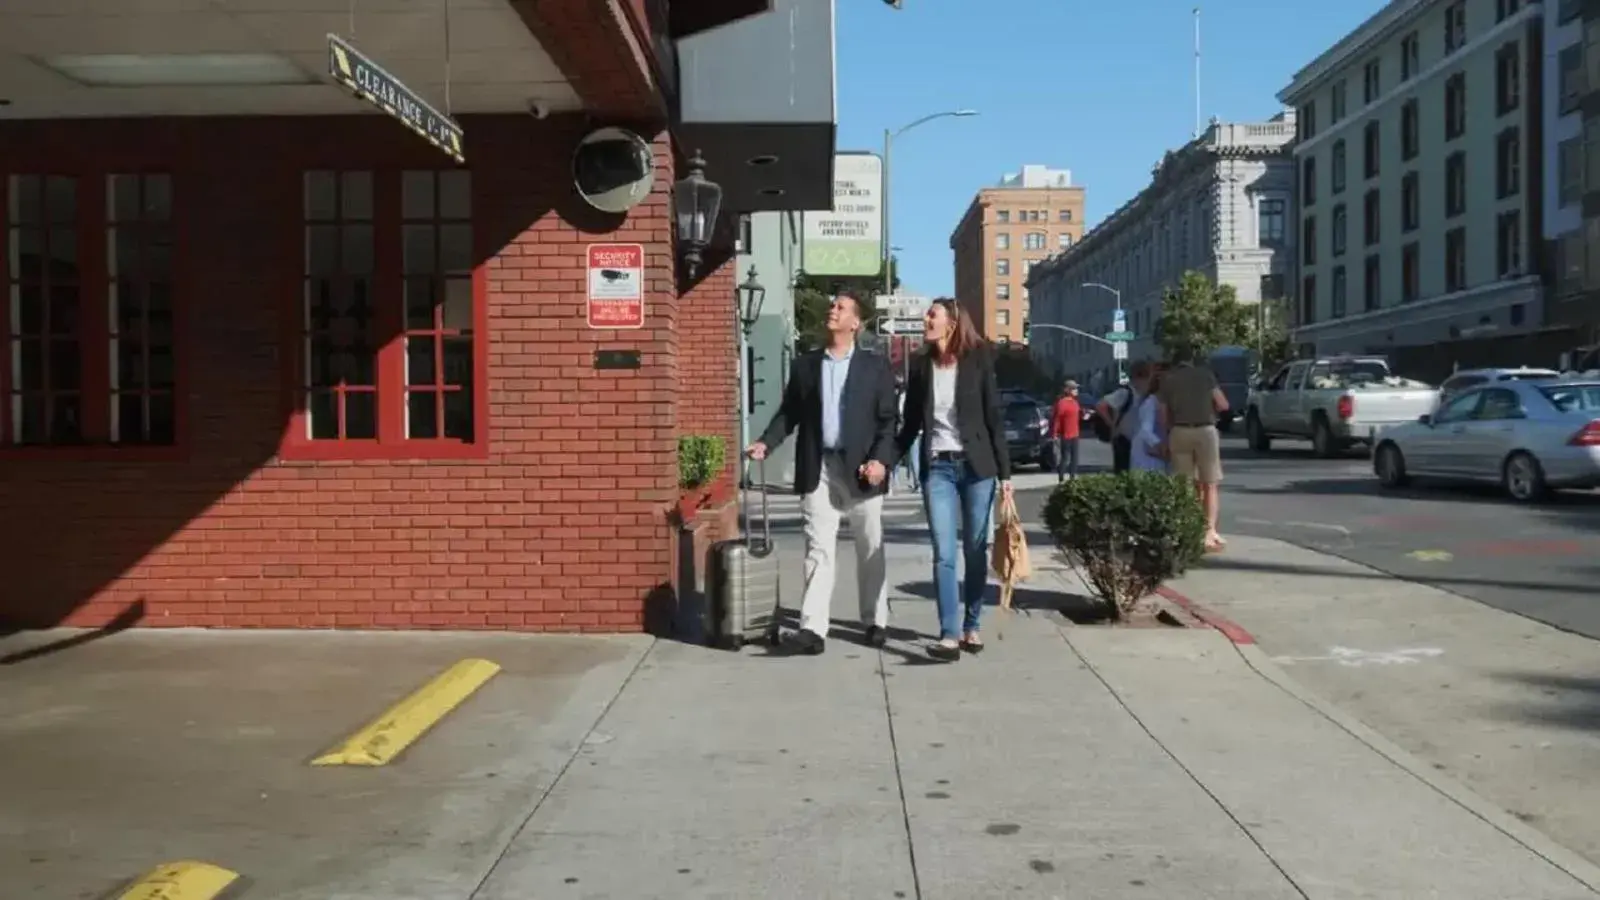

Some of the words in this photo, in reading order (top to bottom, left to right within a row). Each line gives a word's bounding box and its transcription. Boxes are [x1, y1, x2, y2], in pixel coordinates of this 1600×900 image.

[355, 64, 422, 125] CLEARANCE
[593, 251, 636, 260] SECURITY
[599, 259, 631, 267] NOTICE
